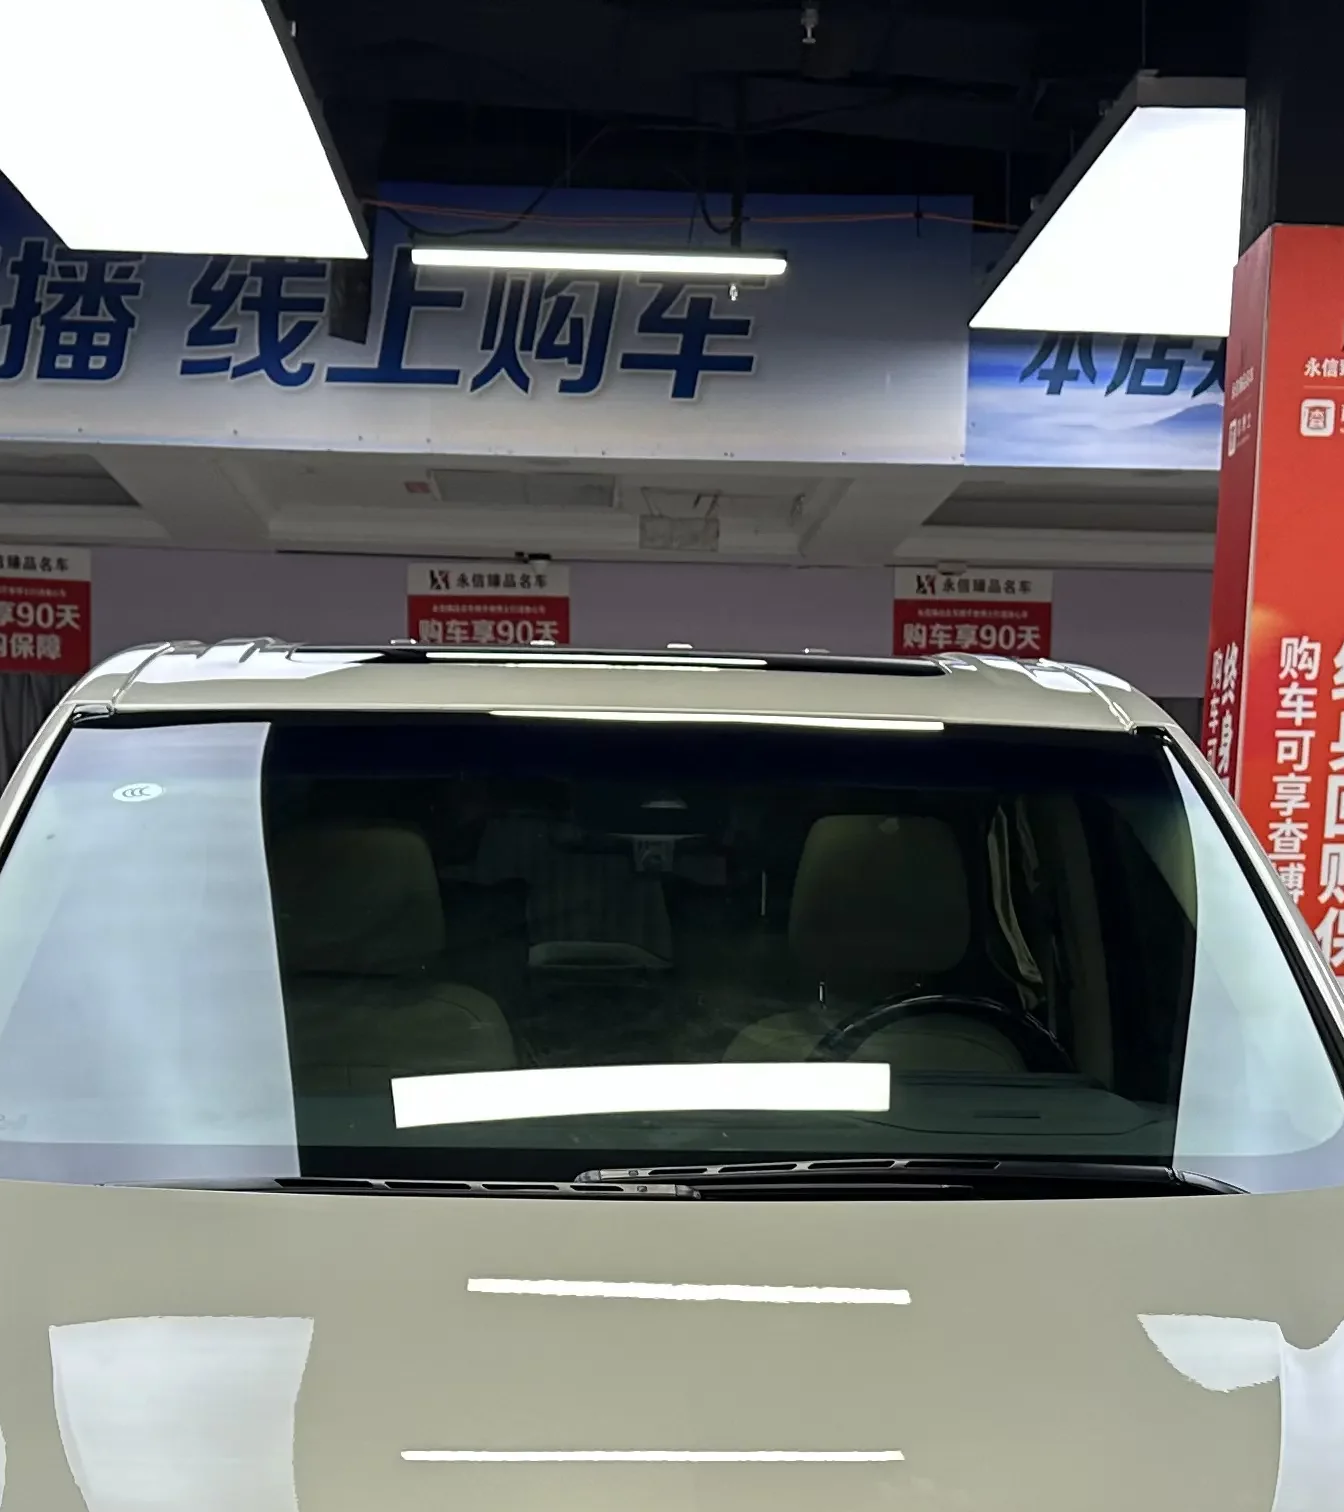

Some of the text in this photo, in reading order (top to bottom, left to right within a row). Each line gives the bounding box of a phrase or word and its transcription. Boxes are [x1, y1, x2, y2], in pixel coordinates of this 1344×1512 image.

[179, 246, 756, 399] 线上购车
[418, 619, 560, 645] 购车享90天
[902, 622, 1042, 651] 购车享90天
